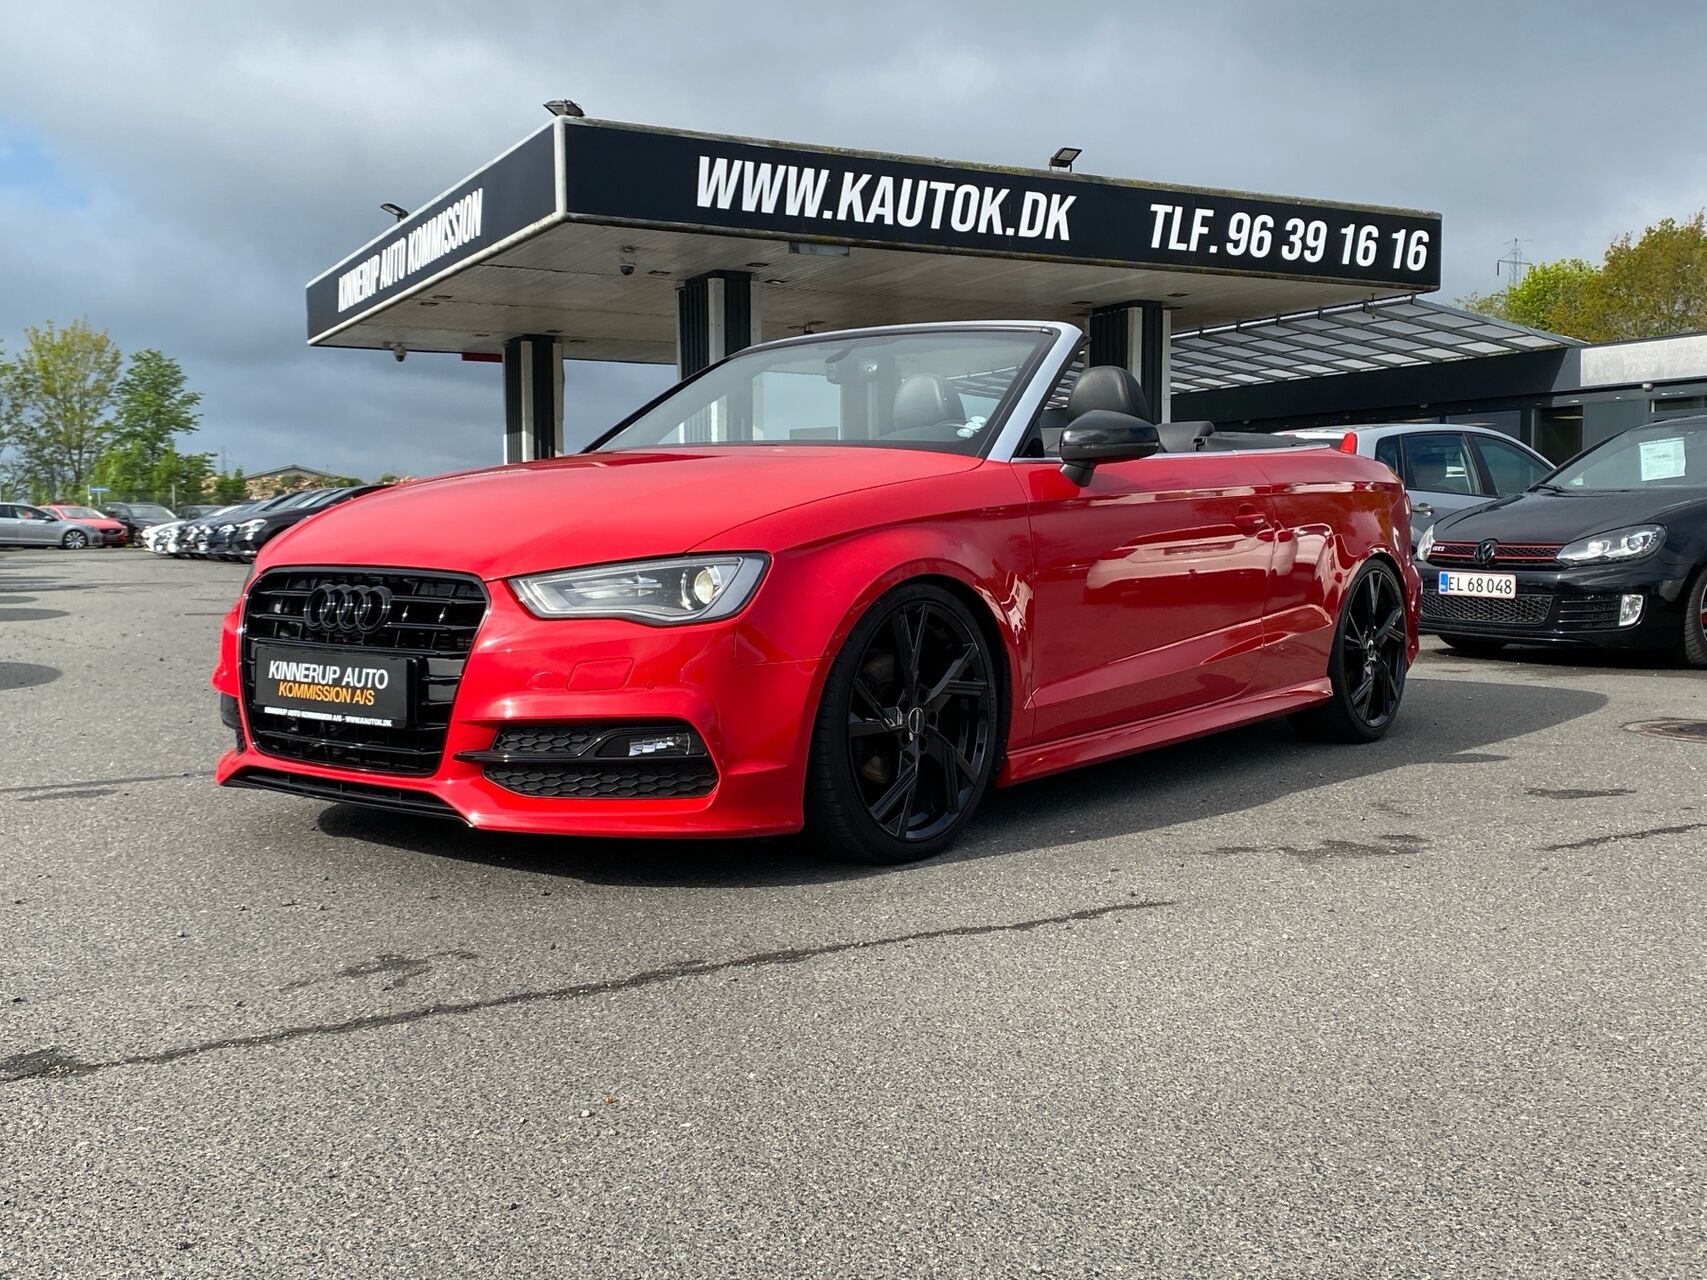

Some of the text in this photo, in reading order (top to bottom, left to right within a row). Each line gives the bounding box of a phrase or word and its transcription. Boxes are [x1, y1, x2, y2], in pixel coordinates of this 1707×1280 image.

[697, 156, 1077, 241] WWW.KAUTOK.DK
[338, 187, 483, 312] KINNERUP AUTO KOMMISSION
[1150, 203, 1430, 271] TLF. 96 39 16 16
[1448, 576, 1512, 595] EL 68 048
[268, 660, 389, 690] KINNERUP AUTO
[278, 681, 375, 706] KOMMISSION A/S
